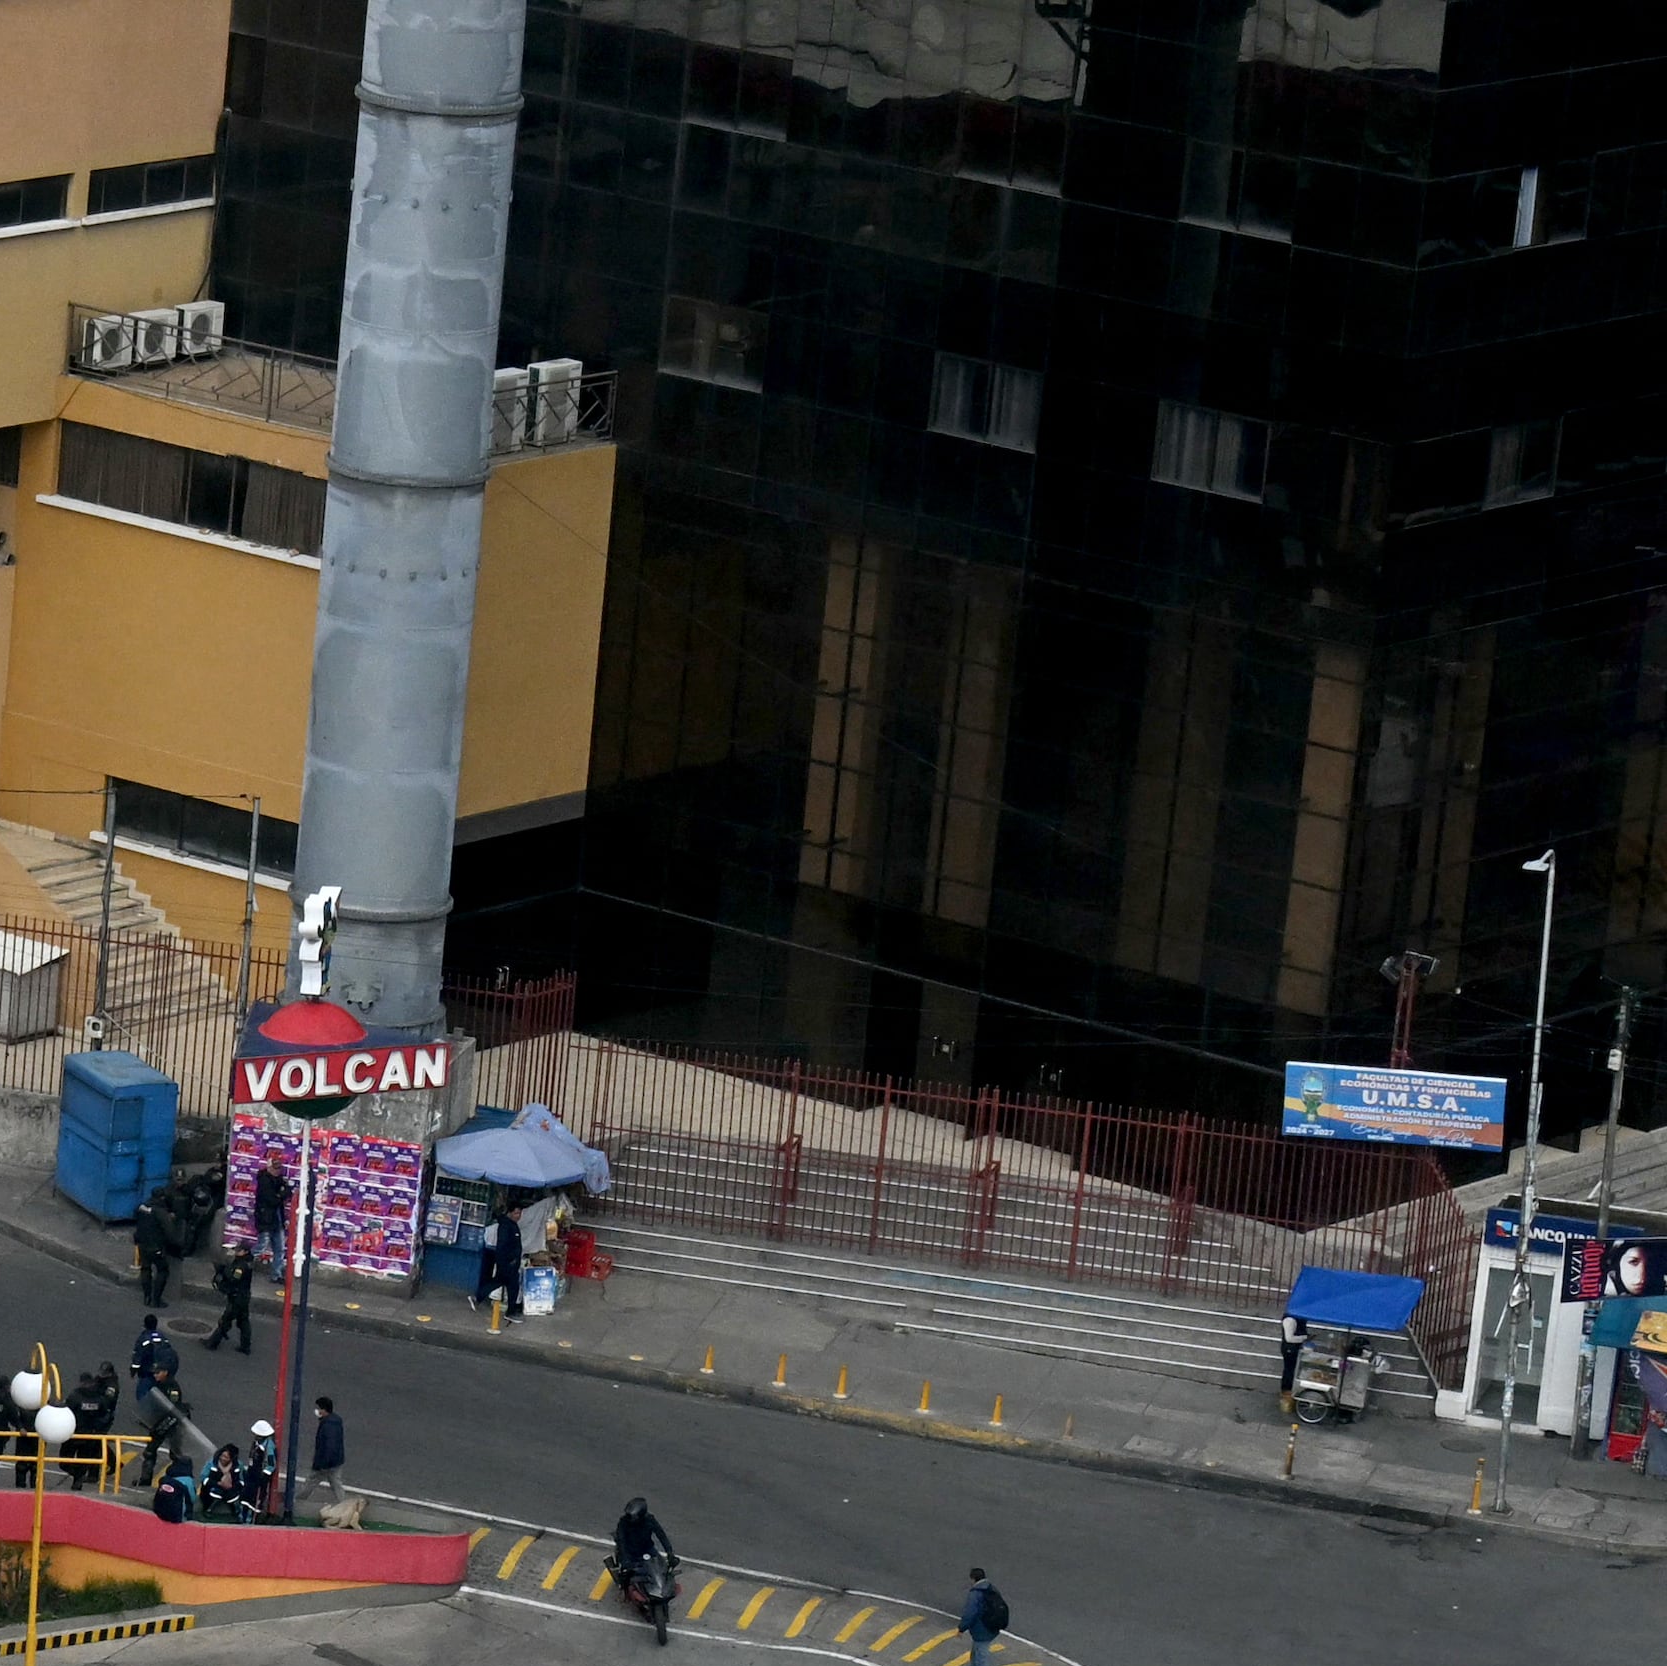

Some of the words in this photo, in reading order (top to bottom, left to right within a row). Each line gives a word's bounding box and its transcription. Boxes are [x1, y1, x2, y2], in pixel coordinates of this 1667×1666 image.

[244, 1047, 447, 1101] VOLCAN
[1356, 1072, 1408, 1084] FACULTAD
[1427, 1079, 1476, 1090] CIENCIAS
[1340, 1079, 1411, 1092] ECONÓMICAS
[1421, 1086, 1491, 1099] FINANCIERAS
[1362, 1090, 1466, 1112] U.M.S.A.
[1337, 1103, 1385, 1114] ECONOMÍA
[1392, 1108, 1450, 1120] CONTADURÍA
[1452, 1113, 1490, 1123] PÚBLICA
[1343, 1112, 1419, 1125] ADMINISTRACIÓN
[1421, 1118, 1433, 1126] DE
[1434, 1119, 1483, 1130] EMPRESAS
[1285, 1126, 1307, 1135] 2024
[1313, 1128, 1335, 1137] 2027
[1569, 1243, 1584, 1295] CAZZU
